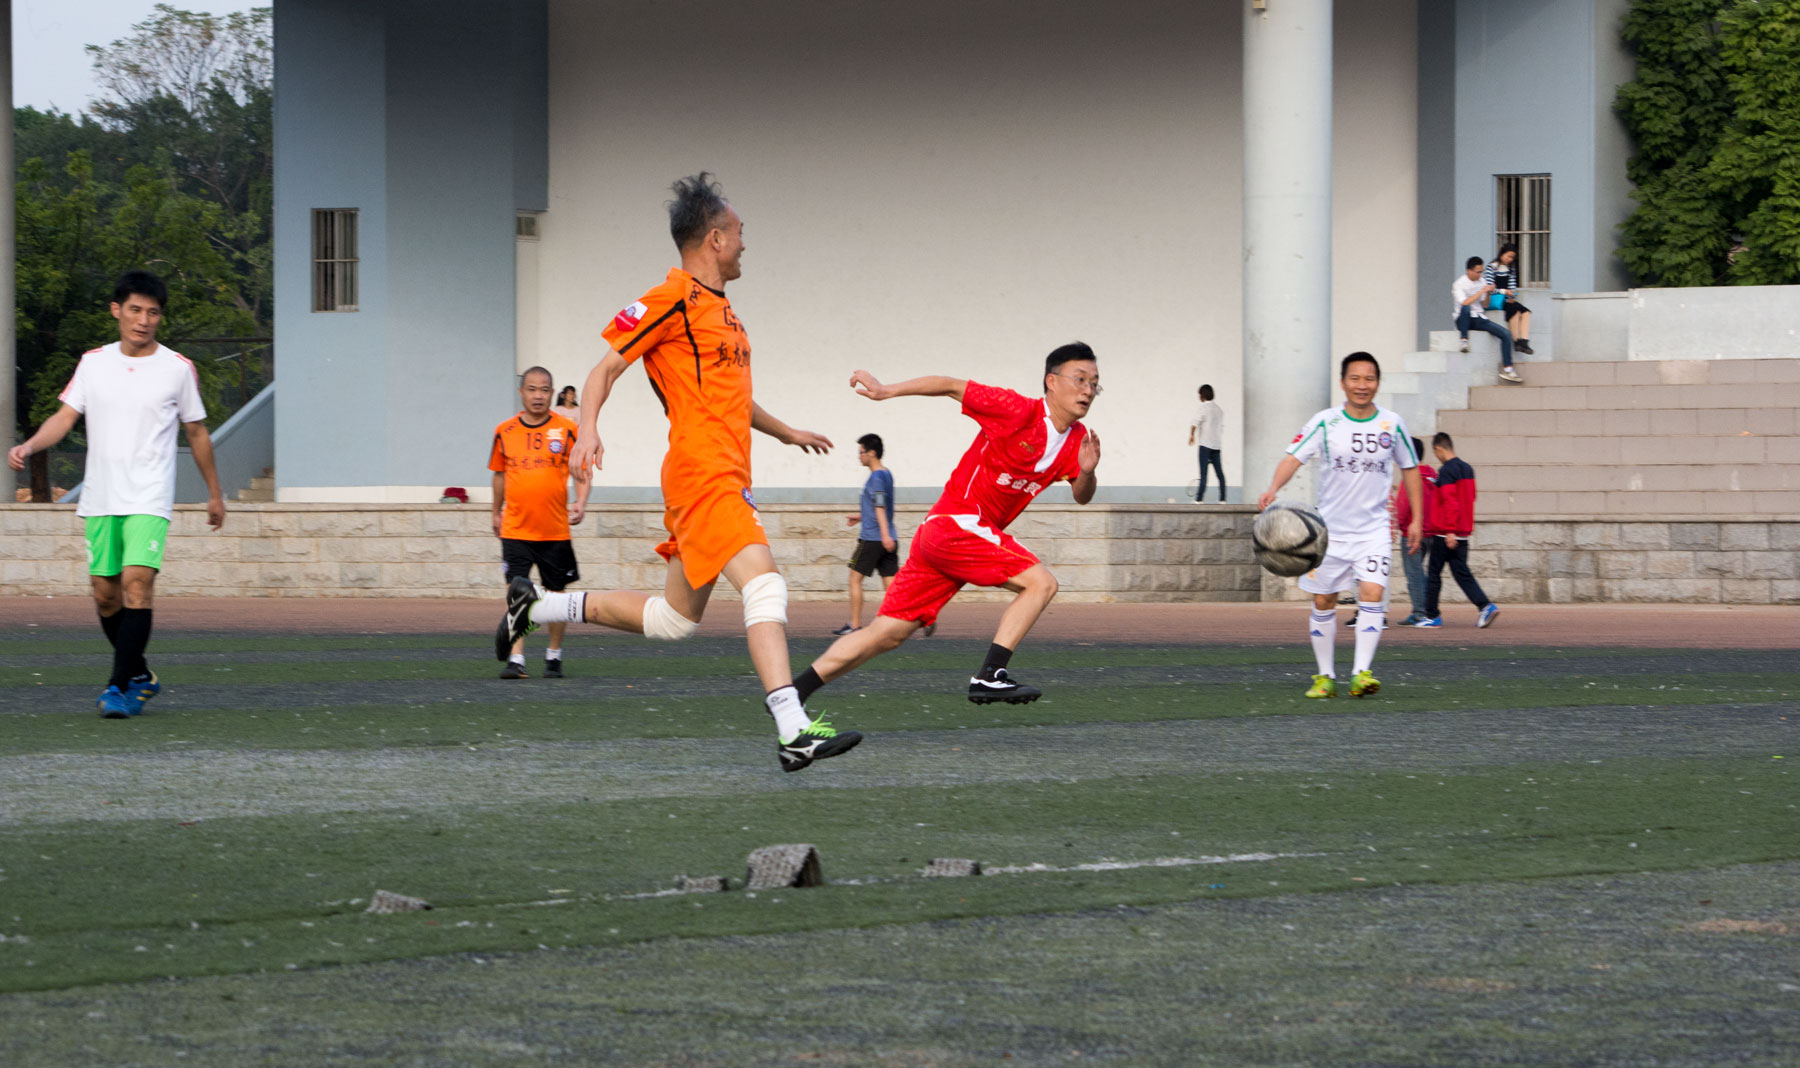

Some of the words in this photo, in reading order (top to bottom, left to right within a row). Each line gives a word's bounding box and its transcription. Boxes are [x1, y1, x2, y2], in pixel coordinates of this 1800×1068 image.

[526, 432, 543, 450] 18
[1351, 432, 1378, 453] 55
[1367, 555, 1391, 577] 55
